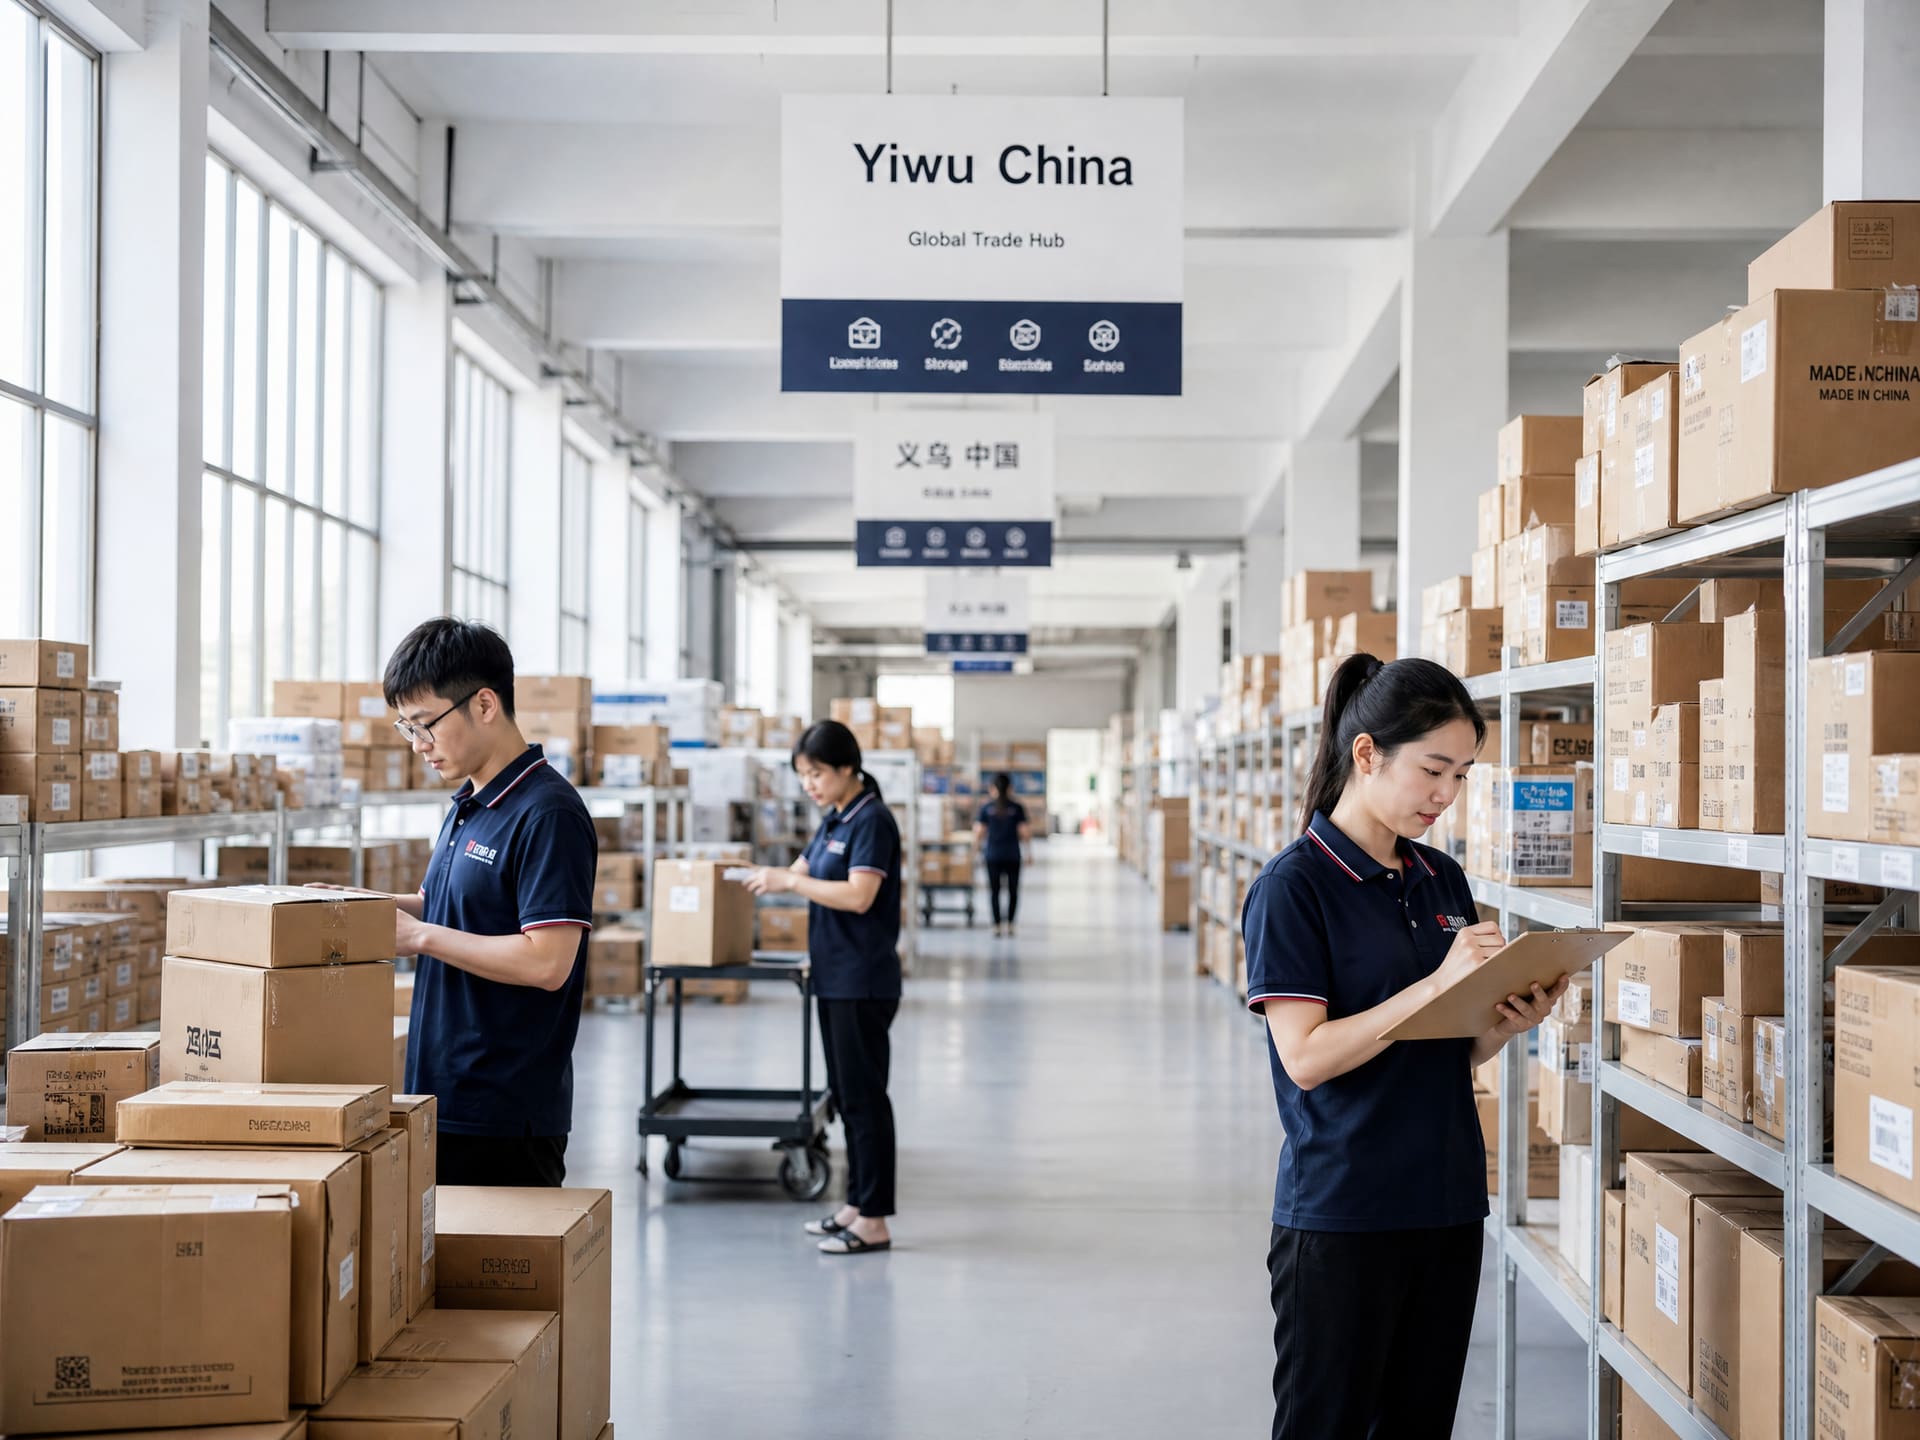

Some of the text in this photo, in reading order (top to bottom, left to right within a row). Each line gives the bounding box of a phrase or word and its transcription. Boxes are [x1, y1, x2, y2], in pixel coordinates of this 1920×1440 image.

[854, 144, 1133, 186] Yiwu China
[908, 231, 1065, 248] Global Trade Hub
[1809, 365, 1857, 381] MADE
[1819, 389, 1911, 401] MADE IN CHINA
[897, 442, 1018, 469] 义乌 中国
